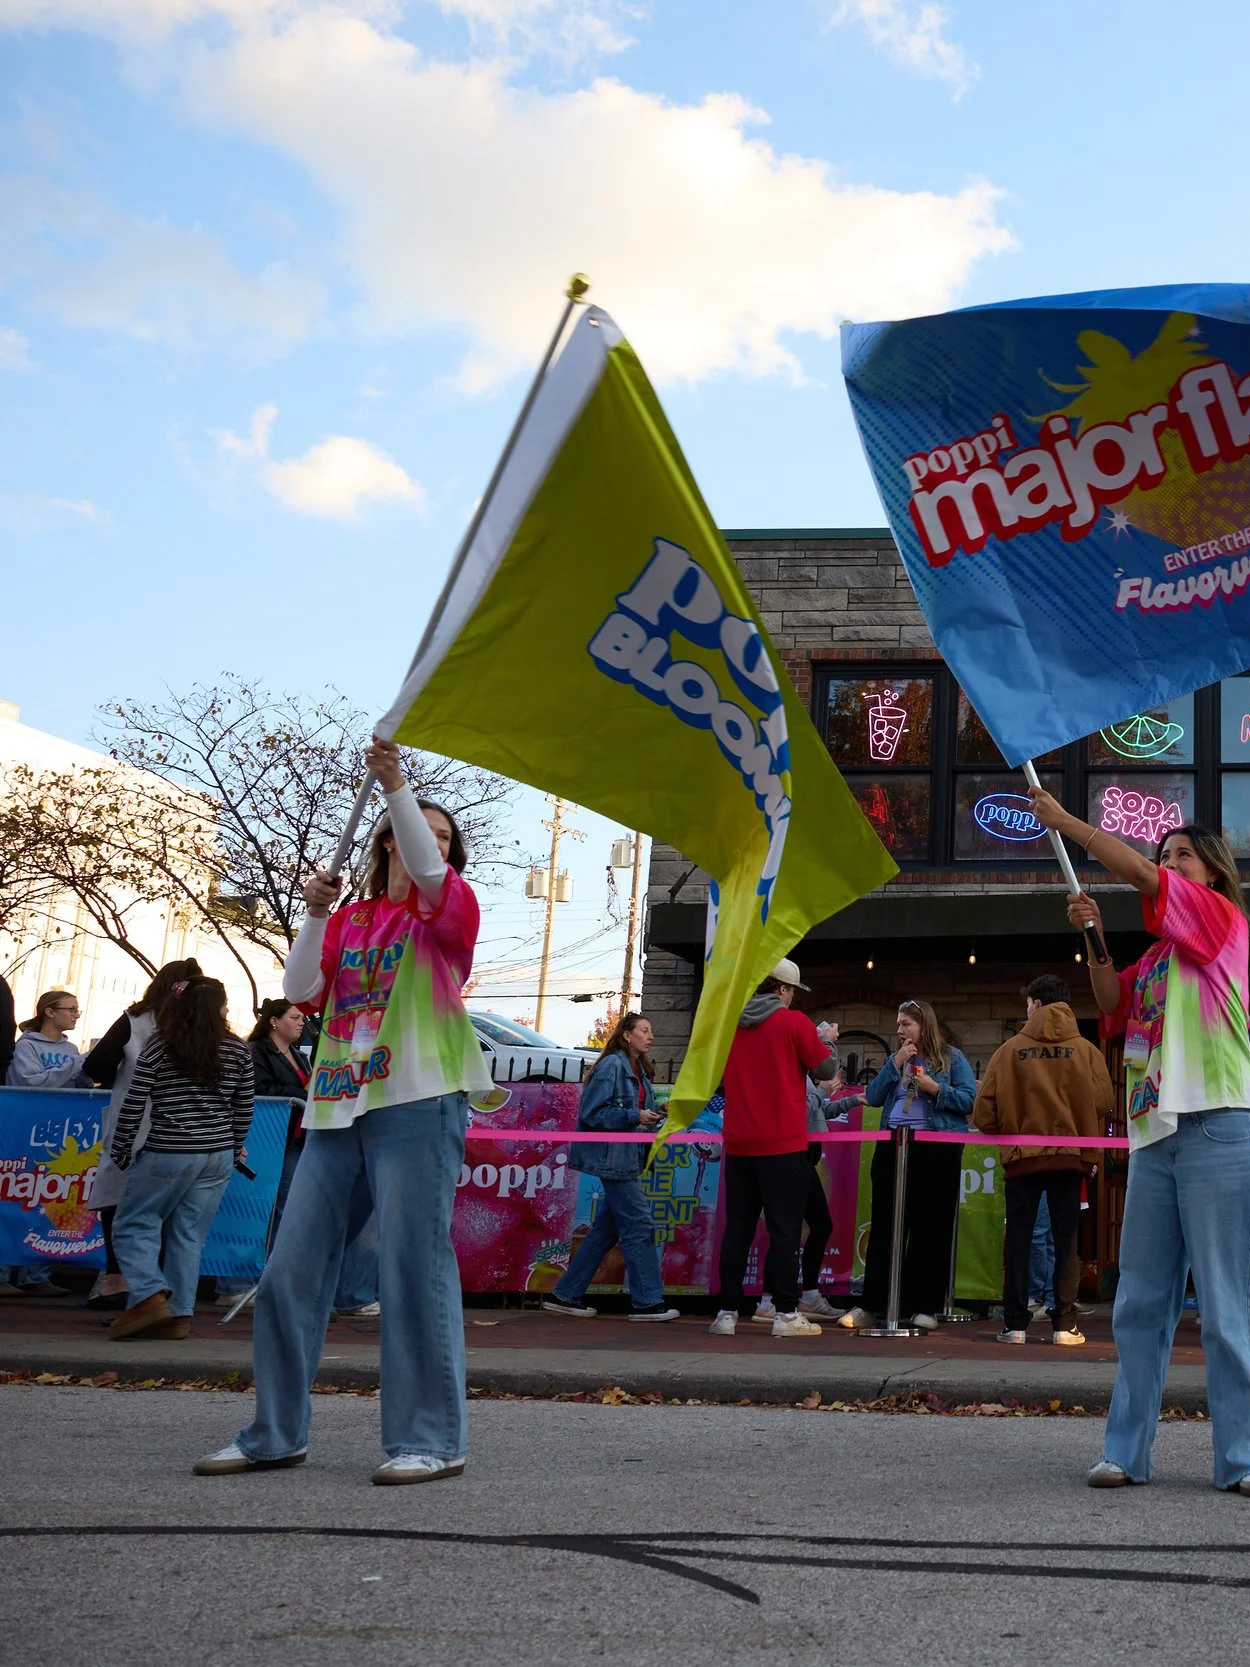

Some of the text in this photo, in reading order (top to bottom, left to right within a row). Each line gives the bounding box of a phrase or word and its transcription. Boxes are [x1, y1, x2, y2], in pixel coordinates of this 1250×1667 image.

[903, 415, 1016, 491] poppi
[1163, 537, 1219, 573] ENTER
[1101, 786, 1184, 826] SODA
[1017, 1046, 1076, 1061] STAFF
[313, 1048, 389, 1101] MAR
[0, 1156, 27, 1174] oppi
[641, 1171, 672, 1193] HE
[651, 1199, 698, 1222] ENT
[24, 1231, 105, 1255] Flavorverse
[48, 1229, 85, 1238] ENTER THE
[541, 1239, 560, 1247] SIP
[549, 1252, 571, 1265] Slay
